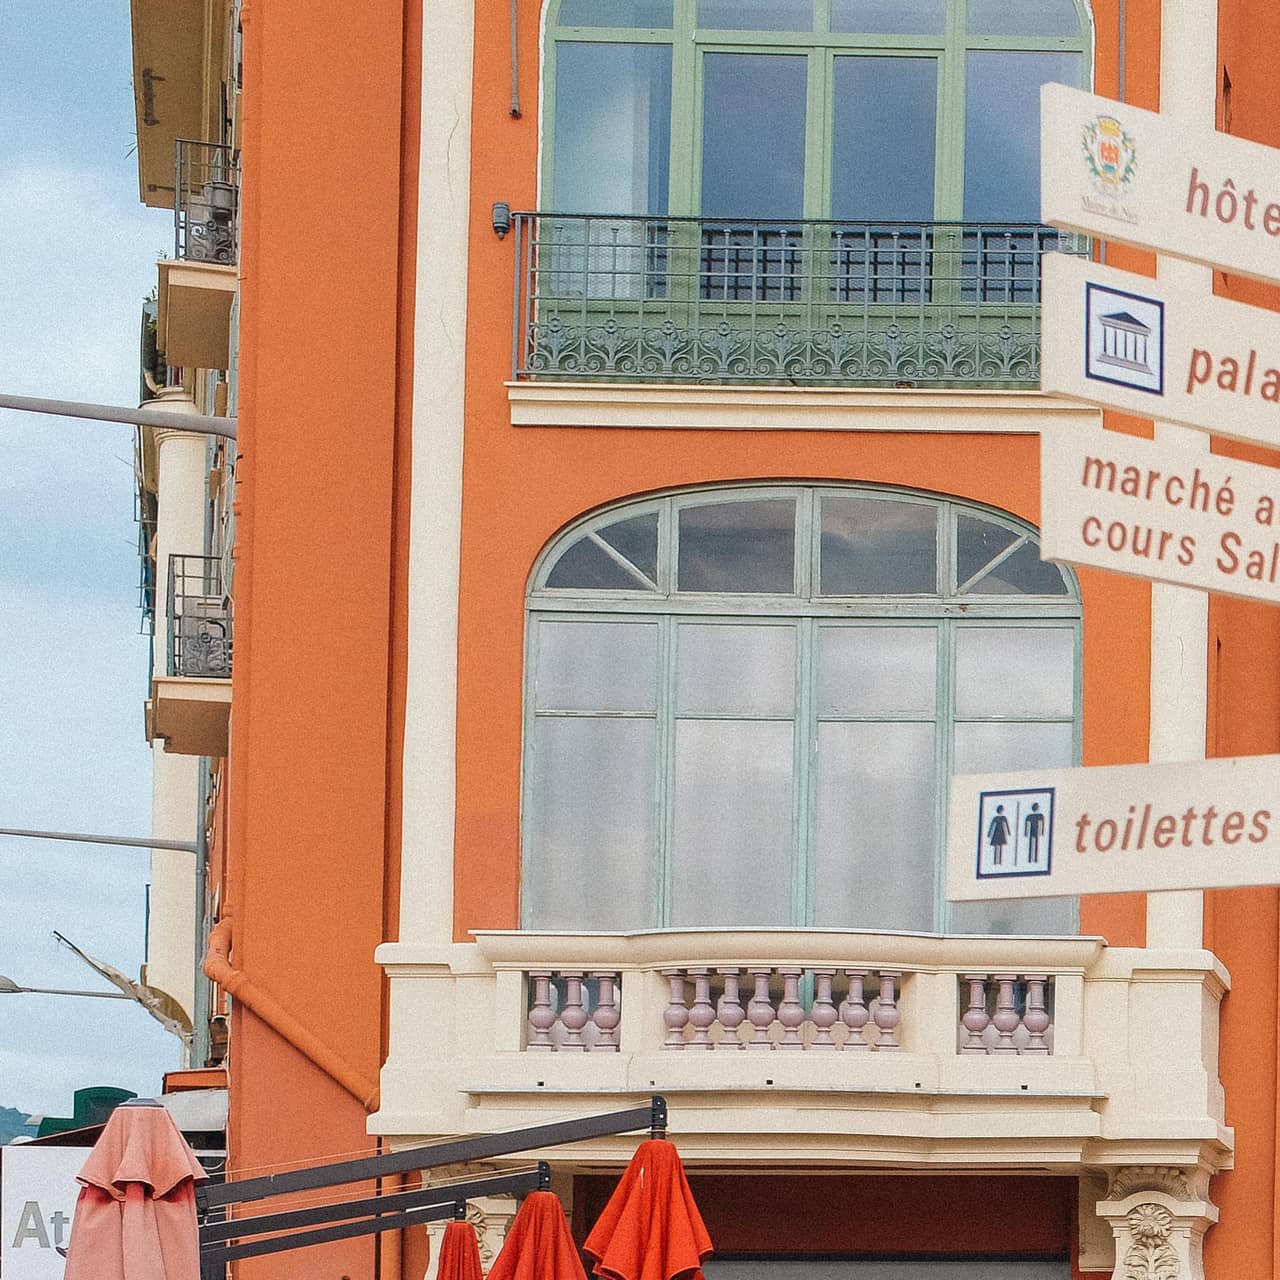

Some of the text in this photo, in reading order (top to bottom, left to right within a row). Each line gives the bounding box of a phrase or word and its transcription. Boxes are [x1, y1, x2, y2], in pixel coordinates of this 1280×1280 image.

[1081, 456, 1235, 516] marché
[1081, 516, 1196, 567] cours
[1075, 805, 1272, 854] toilettes
